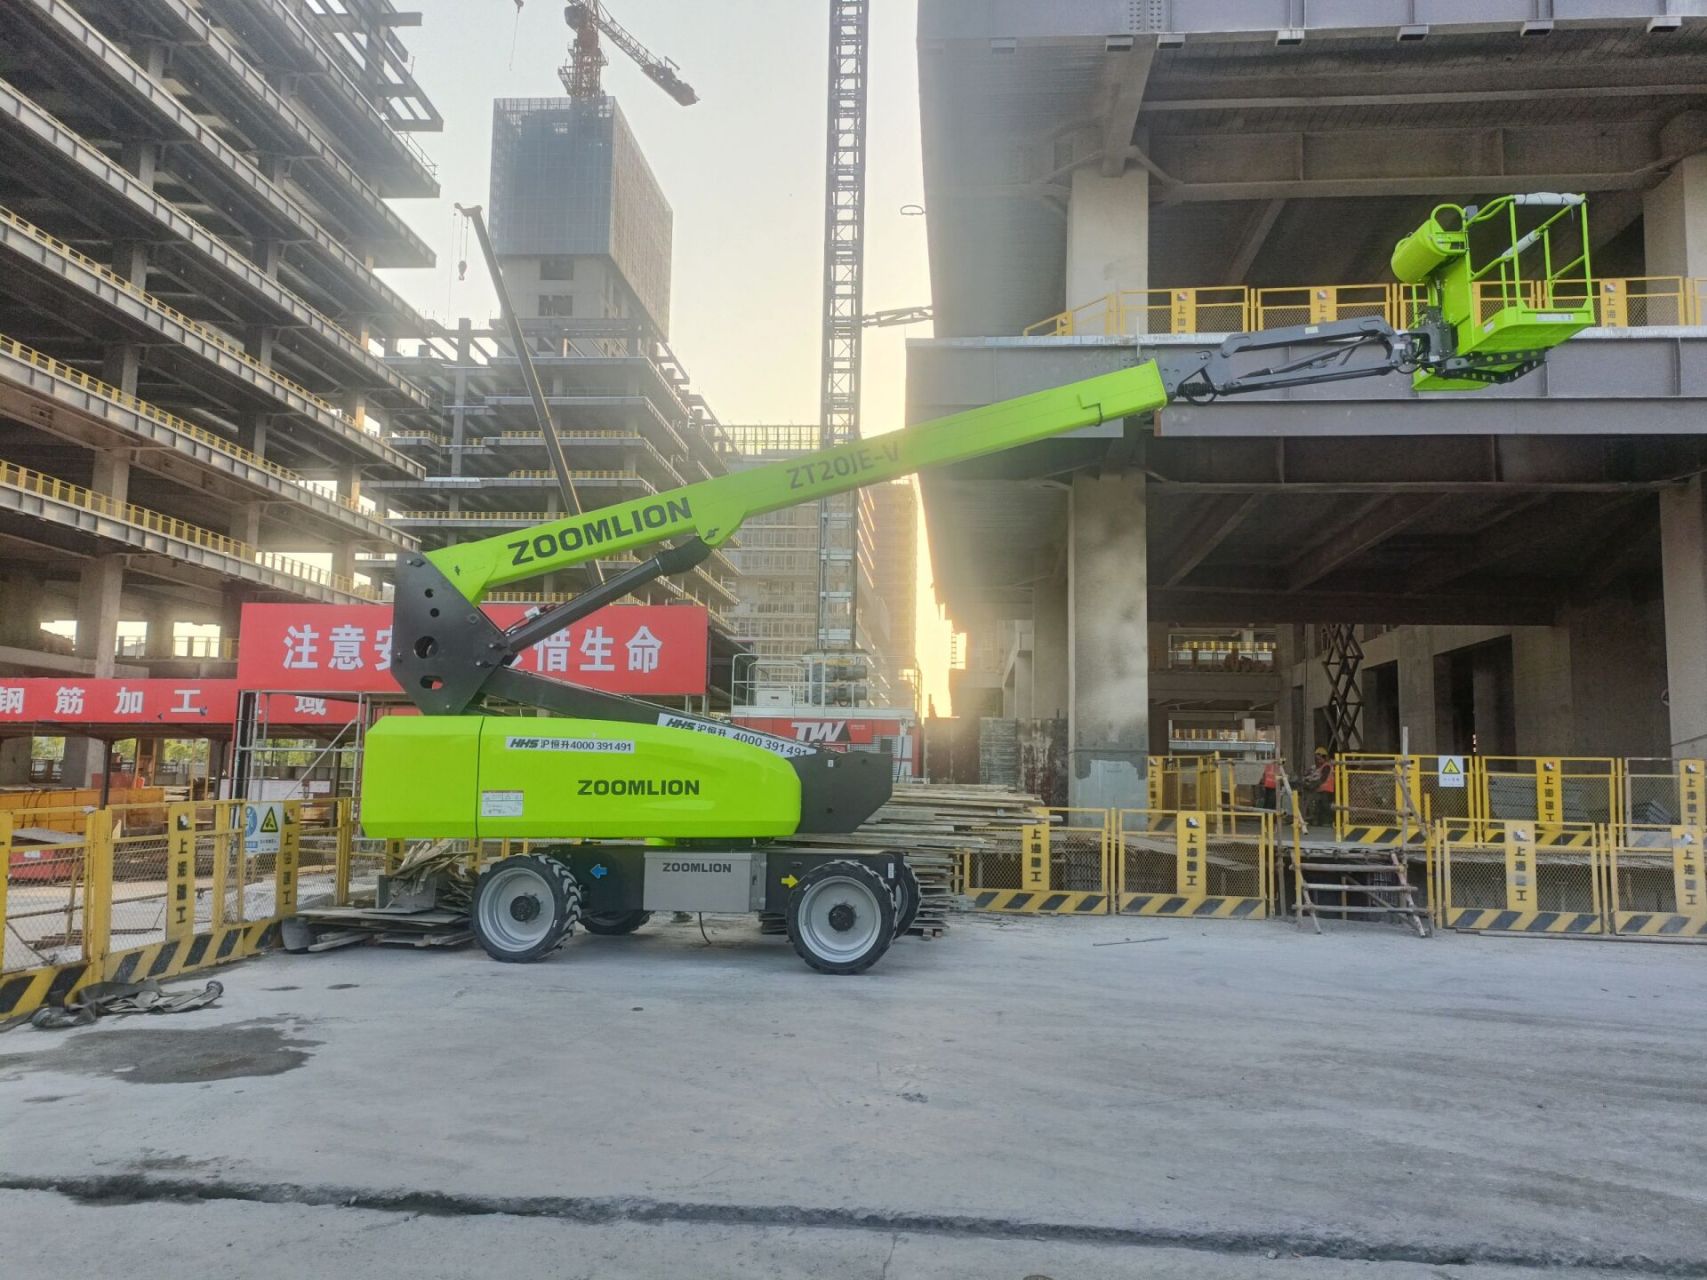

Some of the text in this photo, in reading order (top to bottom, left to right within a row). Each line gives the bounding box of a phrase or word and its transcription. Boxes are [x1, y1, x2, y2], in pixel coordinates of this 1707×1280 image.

[786, 447, 900, 490] ZT20JE-V
[508, 497, 692, 566] ZOOMLION
[509, 625, 663, 673] 惜生命
[0, 687, 327, 716] 钢筋加工域
[510, 738, 539, 748] HHS
[570, 741, 595, 750] 4000
[597, 742, 614, 750] 391
[614, 743, 632, 751] 491
[666, 718, 697, 731] HHS
[732, 732, 763, 747] 4000
[764, 739, 785, 752] 391
[577, 779, 700, 796] ZOOMLION
[663, 863, 732, 873] ZOOMLION
